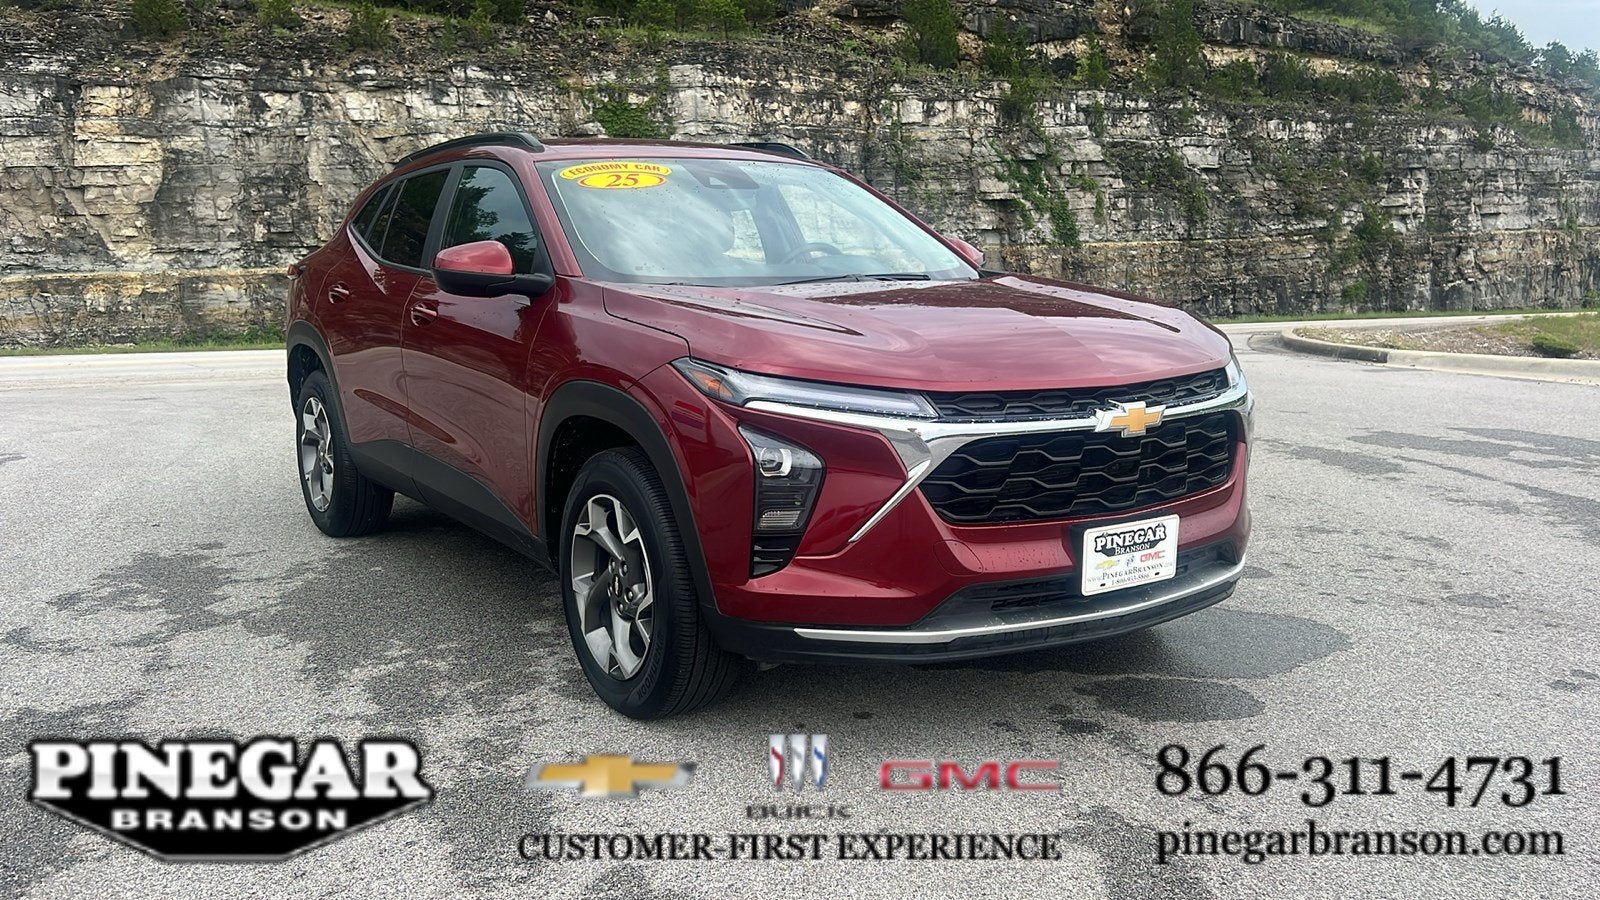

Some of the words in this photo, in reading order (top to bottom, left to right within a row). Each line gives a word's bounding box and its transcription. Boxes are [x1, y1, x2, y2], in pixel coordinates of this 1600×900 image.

[569, 163, 628, 176] ECONOMY
[634, 164, 661, 173] CAR
[605, 173, 640, 188] 25
[1095, 526, 1166, 552] PINEGAR
[1114, 542, 1151, 556] BRANSON
[1140, 550, 1166, 563] GMC
